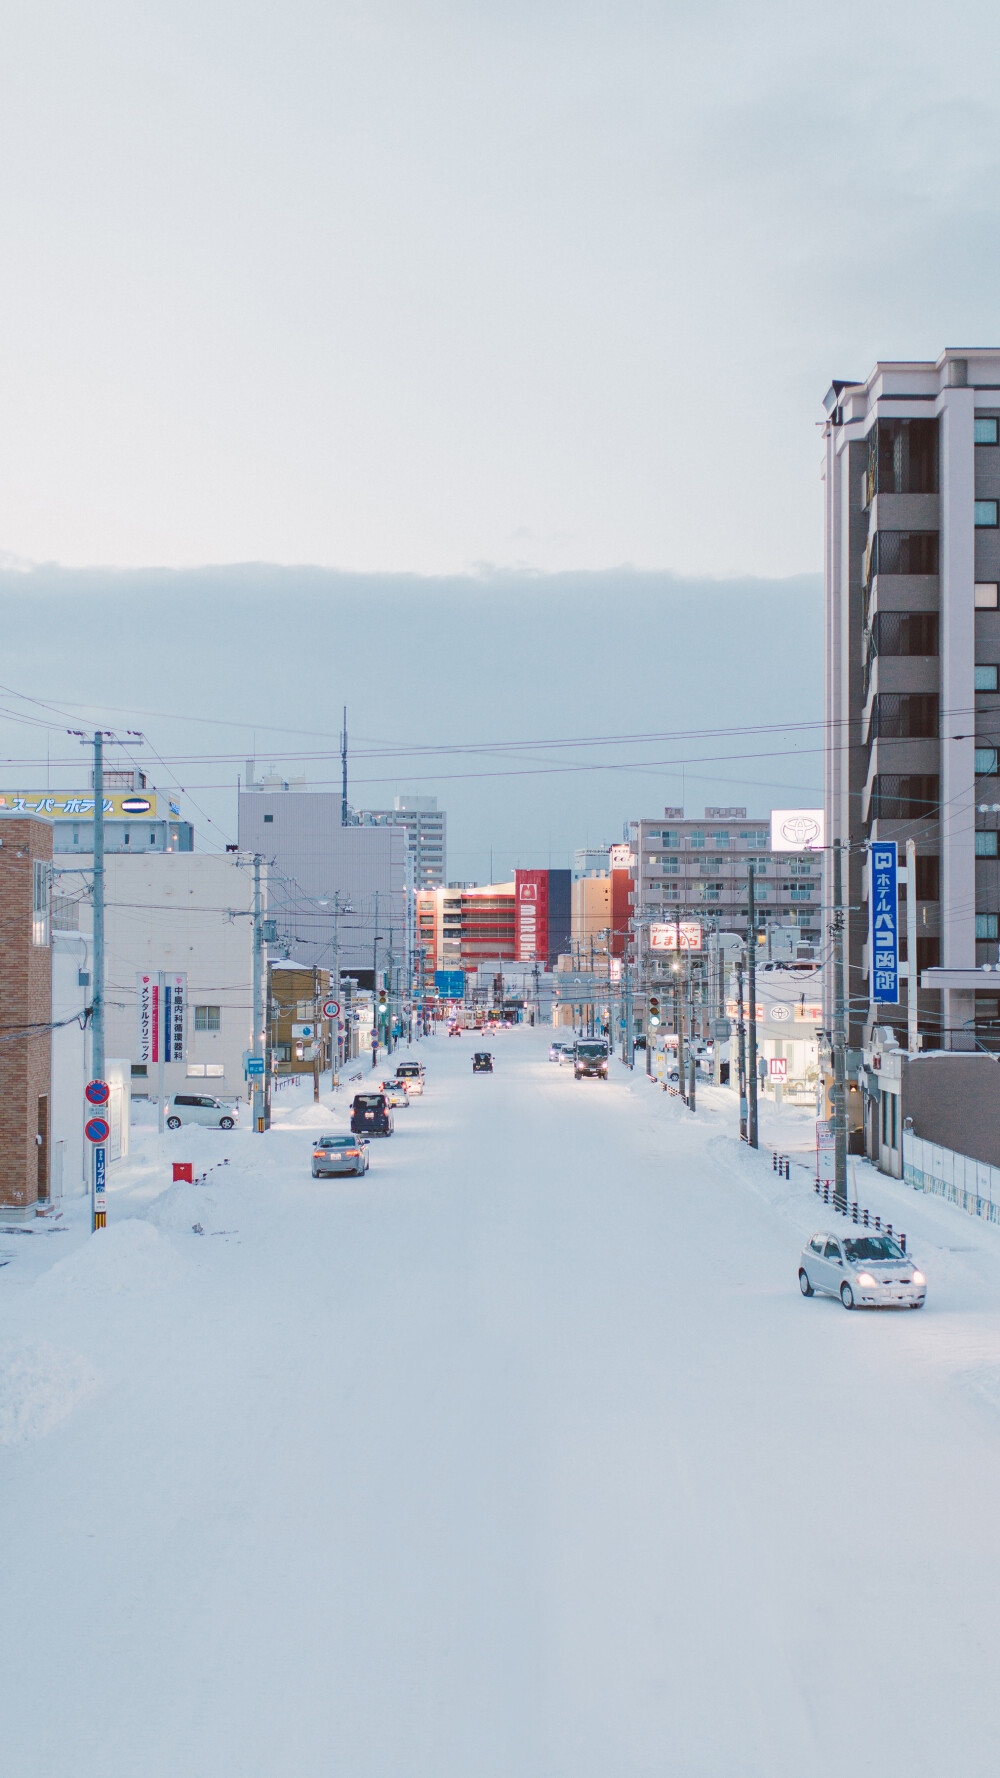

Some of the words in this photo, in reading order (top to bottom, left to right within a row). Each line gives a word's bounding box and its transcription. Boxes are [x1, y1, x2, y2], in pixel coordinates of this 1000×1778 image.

[652, 935, 698, 946] しまむら
[875, 873, 895, 990] ホテルパコ函館
[141, 987, 150, 1061] メンタルクリニック
[174, 987, 183, 1060] 中島内科循環器科
[326, 1005, 337, 1014] 40
[771, 1060, 786, 1074] IN
